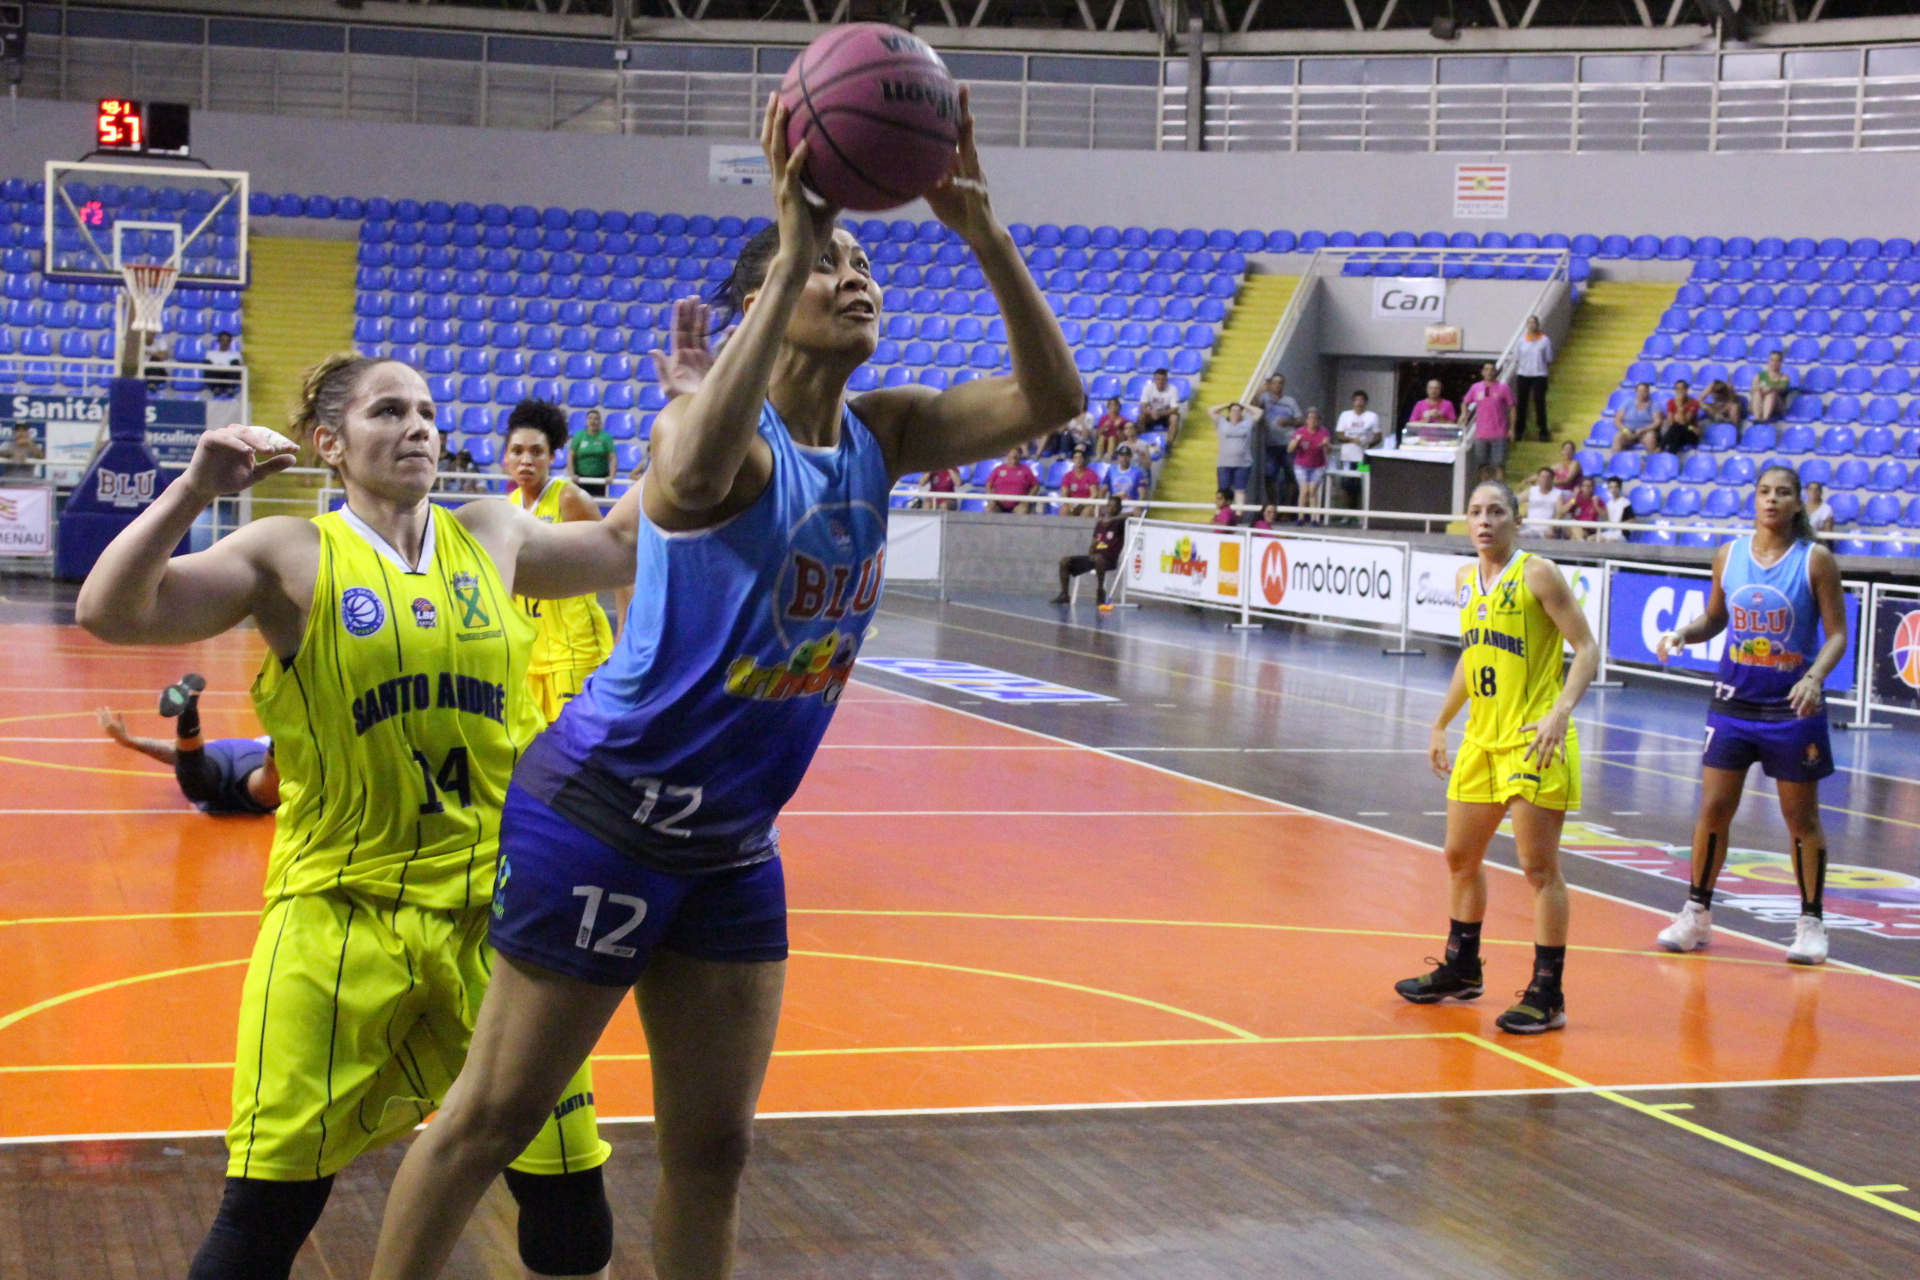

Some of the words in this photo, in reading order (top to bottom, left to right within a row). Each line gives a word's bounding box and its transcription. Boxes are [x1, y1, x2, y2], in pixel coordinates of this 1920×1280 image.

[1381, 289, 1440, 311] Can
[98, 468, 157, 500] BLU
[785, 544, 885, 622] BLU
[1292, 556, 1392, 600] motorola
[1732, 603, 1788, 634] BLU
[352, 672, 430, 737] SANTO
[412, 746, 473, 814] 14
[630, 776, 704, 839] 12
[571, 884, 648, 958] 12
